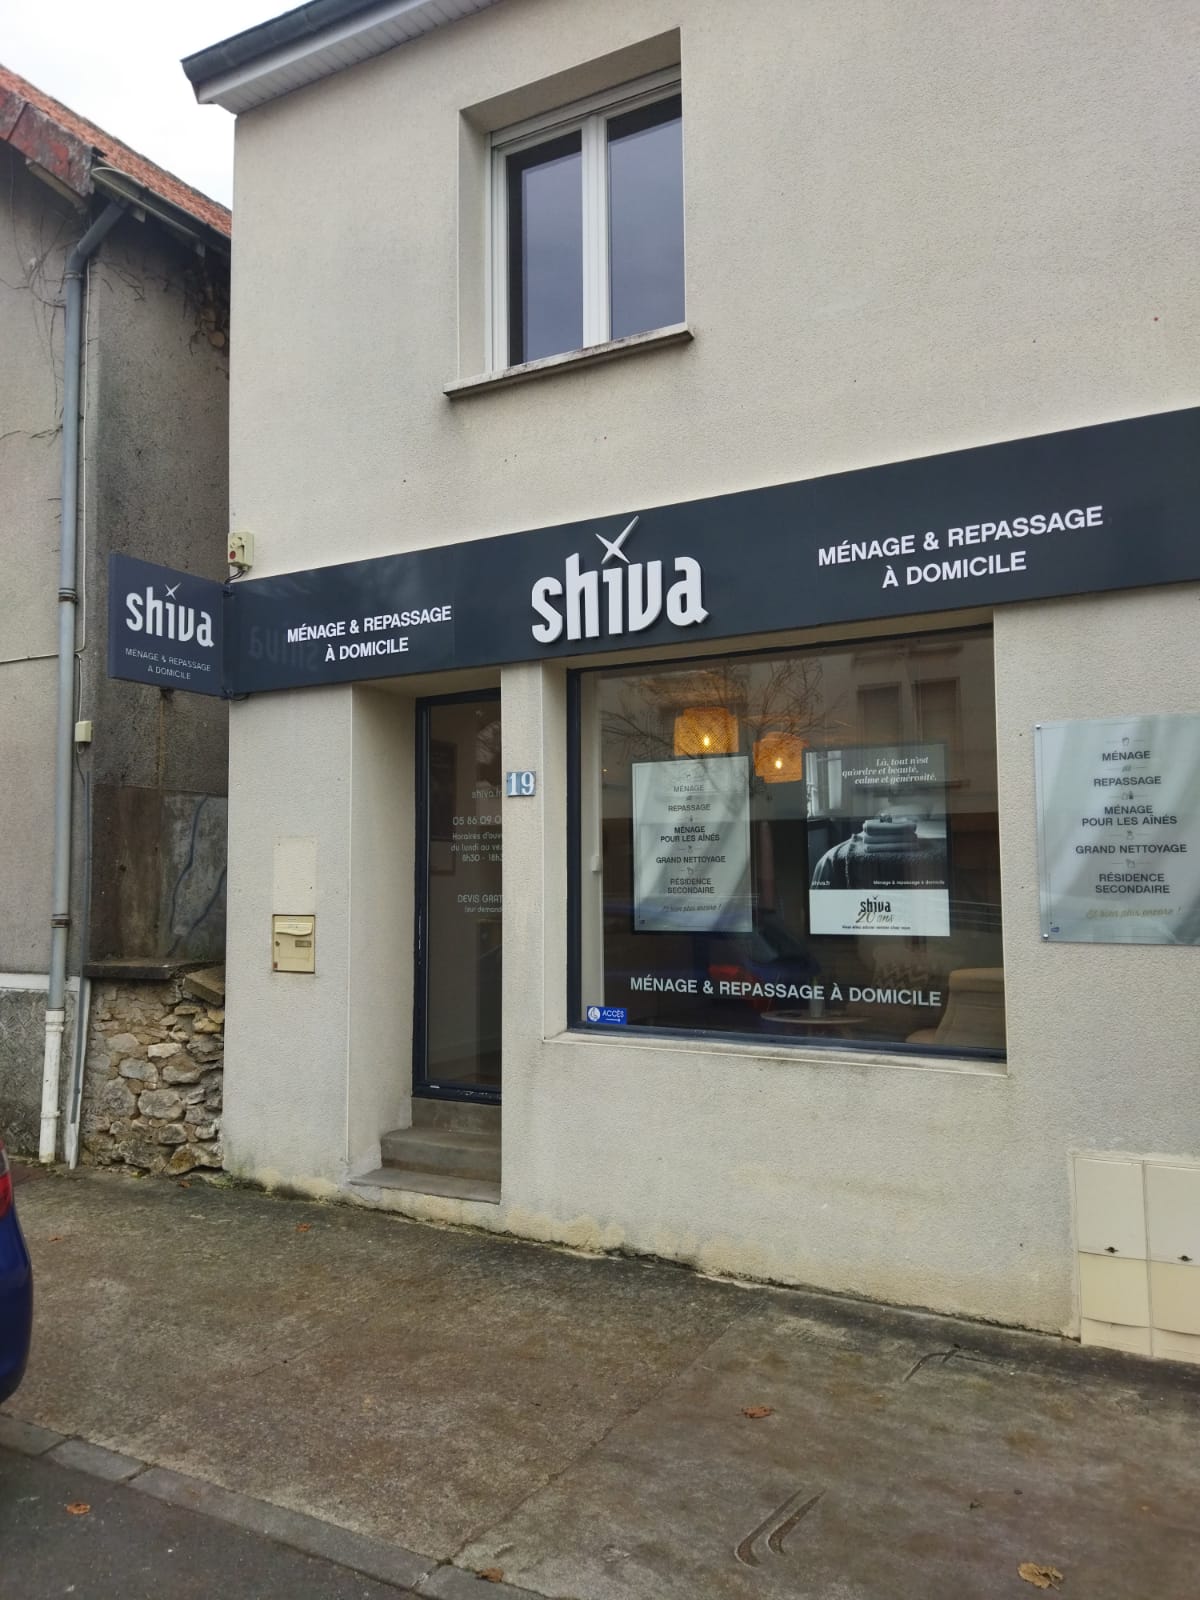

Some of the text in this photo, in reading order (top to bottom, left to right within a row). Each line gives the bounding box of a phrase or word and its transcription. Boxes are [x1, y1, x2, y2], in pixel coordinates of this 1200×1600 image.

[818, 505, 1103, 566] MÉNAGE & REPASSAGE
[882, 551, 1027, 588] À DOMICILE
[531, 516, 709, 643] shiva
[126, 583, 214, 648] shiva
[287, 605, 452, 643] MÉNAGE & REPASSAGE
[325, 637, 409, 662] À DOMICILE
[168, 656, 211, 672] REPASSAGE
[155, 666, 191, 680] DOMICILE
[1102, 750, 1151, 761] MÉNAGE
[509, 772, 535, 795] 19
[1093, 776, 1162, 787] REPASSAGE
[668, 803, 711, 812] REPASSAGE
[1104, 804, 1153, 815] MÉNAGE
[452, 816, 465, 826] 05
[480, 815, 492, 825] 09
[1082, 817, 1113, 827] POUR
[1117, 816, 1139, 826] LES
[660, 835, 680, 843] POUR
[681, 834, 696, 842] LES
[461, 843, 479, 852] lundi
[1075, 844, 1188, 854] GRAND NETTOYAGE
[656, 855, 726, 864] GRAND NETTOYAGE
[1099, 872, 1165, 882] RÉSIDENCE
[667, 886, 716, 894] SECONDAIRE
[1095, 885, 1171, 894] SECONDAIRE
[457, 894, 480, 903] DEVIS
[860, 895, 891, 912] shiva
[630, 974, 942, 1007] MÉNAGE & REPASSAGE À DOMICILE
